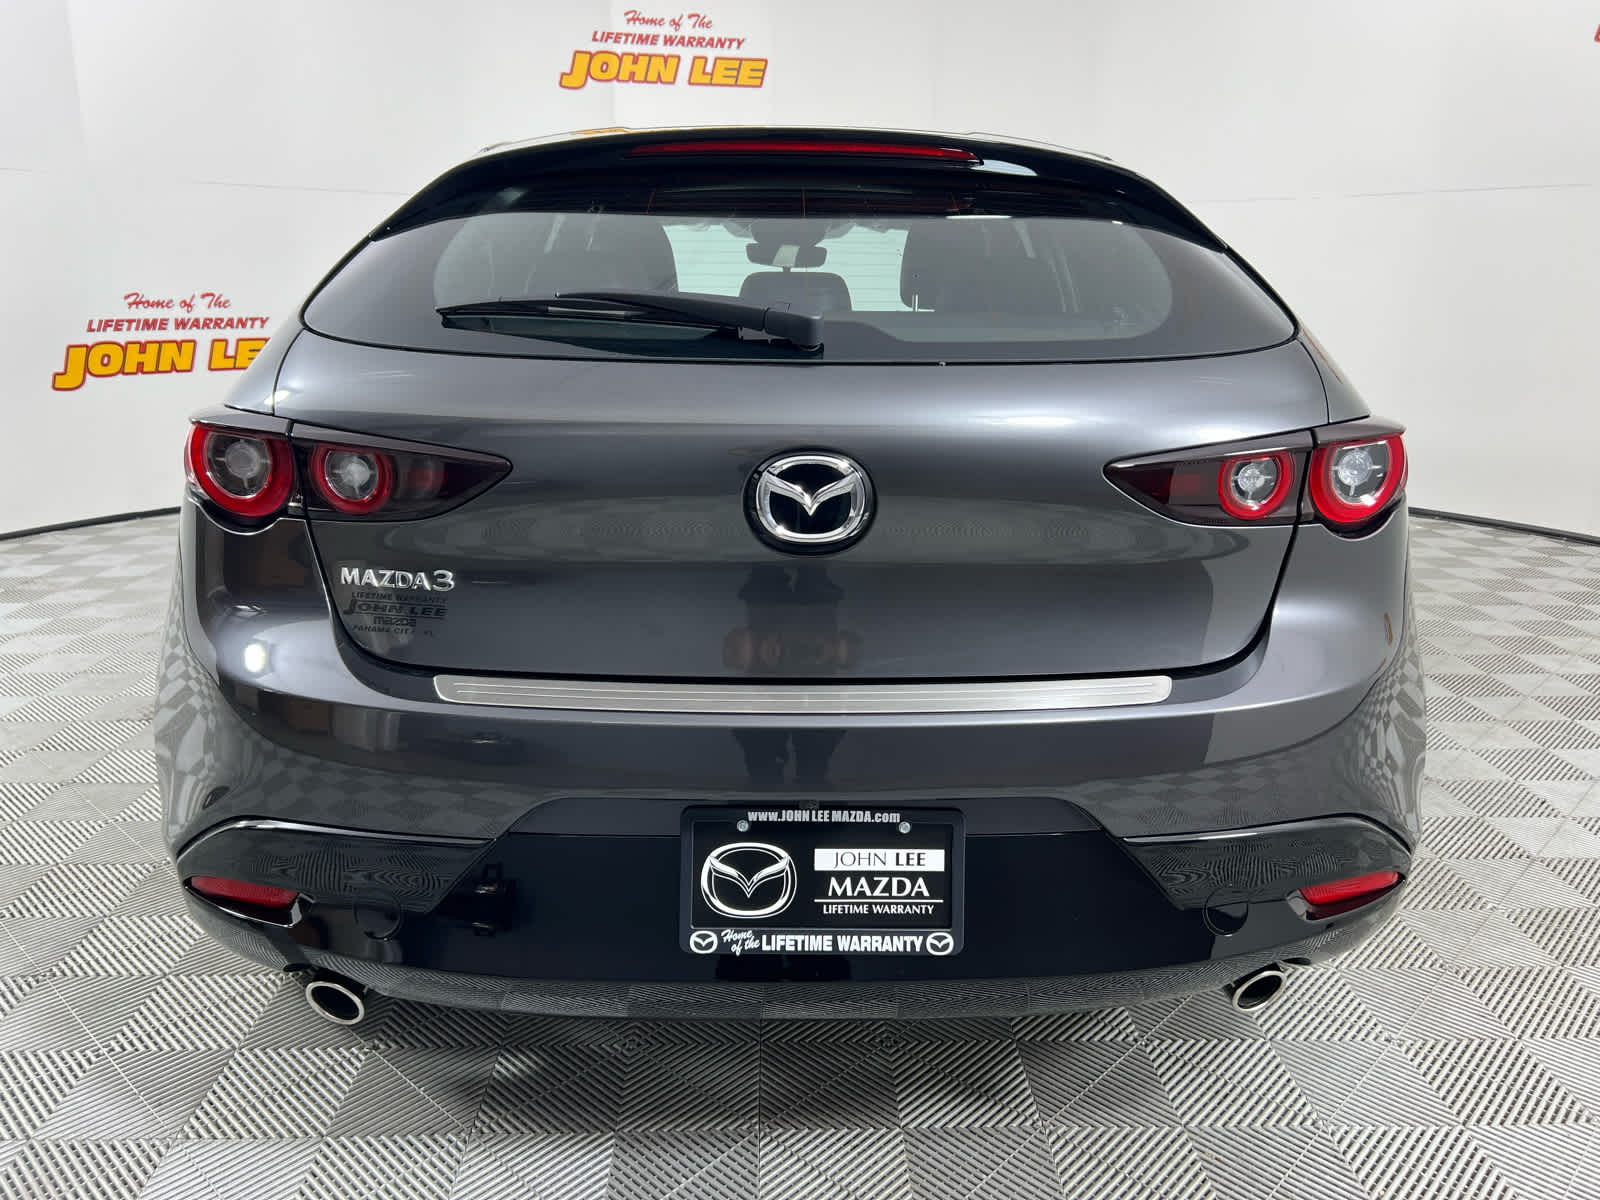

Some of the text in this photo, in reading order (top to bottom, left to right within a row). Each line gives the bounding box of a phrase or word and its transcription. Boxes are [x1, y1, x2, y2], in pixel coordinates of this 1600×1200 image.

[623, 9, 713, 31] Home of The
[591, 30, 746, 50] LIFETIME WARRANTY
[559, 50, 768, 90] JOHN LEE
[124, 292, 231, 313] Home of The
[86, 316, 270, 333] LIFETIME WARRANTY
[52, 337, 270, 391] JOHN LE
[343, 599, 448, 618] JOHN LEE
[811, 810, 830, 822] LEE
[831, 810, 901, 823] MAZDA.com
[833, 851, 926, 868] JOHN LEE
[828, 877, 930, 897] MAZDA
[823, 904, 935, 915] LIFETIME WARRANTY
[721, 929, 753, 943] Home
[761, 934, 924, 952] LIFETIME WARRANTY
[730, 937, 760, 956] of the
